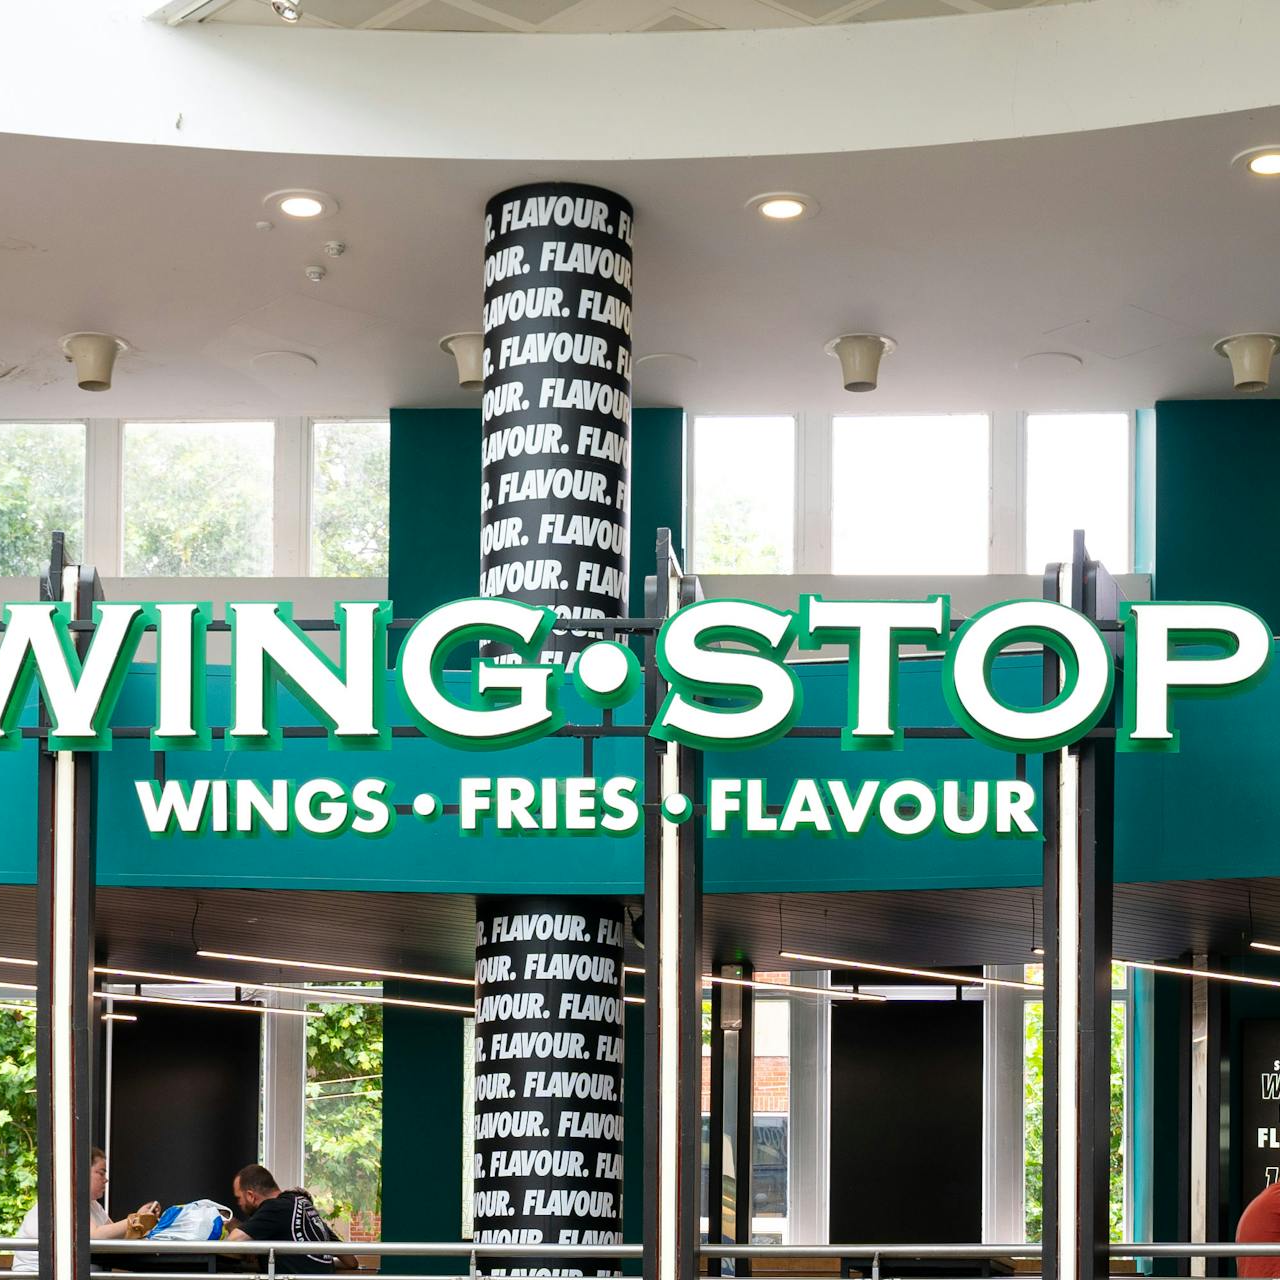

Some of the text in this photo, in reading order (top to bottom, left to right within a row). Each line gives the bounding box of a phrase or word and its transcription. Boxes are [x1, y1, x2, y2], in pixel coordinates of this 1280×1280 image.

[500, 196, 614, 235] FLAVOUR.
[499, 332, 612, 370] FLAVOUR.
[498, 468, 611, 506] FLAVOUR.
[136, 774, 1040, 838] WINGS FRIES FLAVOUR
[491, 914, 591, 943] FLAVOUR.
[524, 954, 618, 985] FLAVOUR.
[490, 1032, 590, 1061] FLAVOUR.
[523, 1071, 617, 1102] FLAVOUR.
[490, 1150, 589, 1178] FLAVOUR.
[522, 1189, 616, 1218] FLAVOUR.
